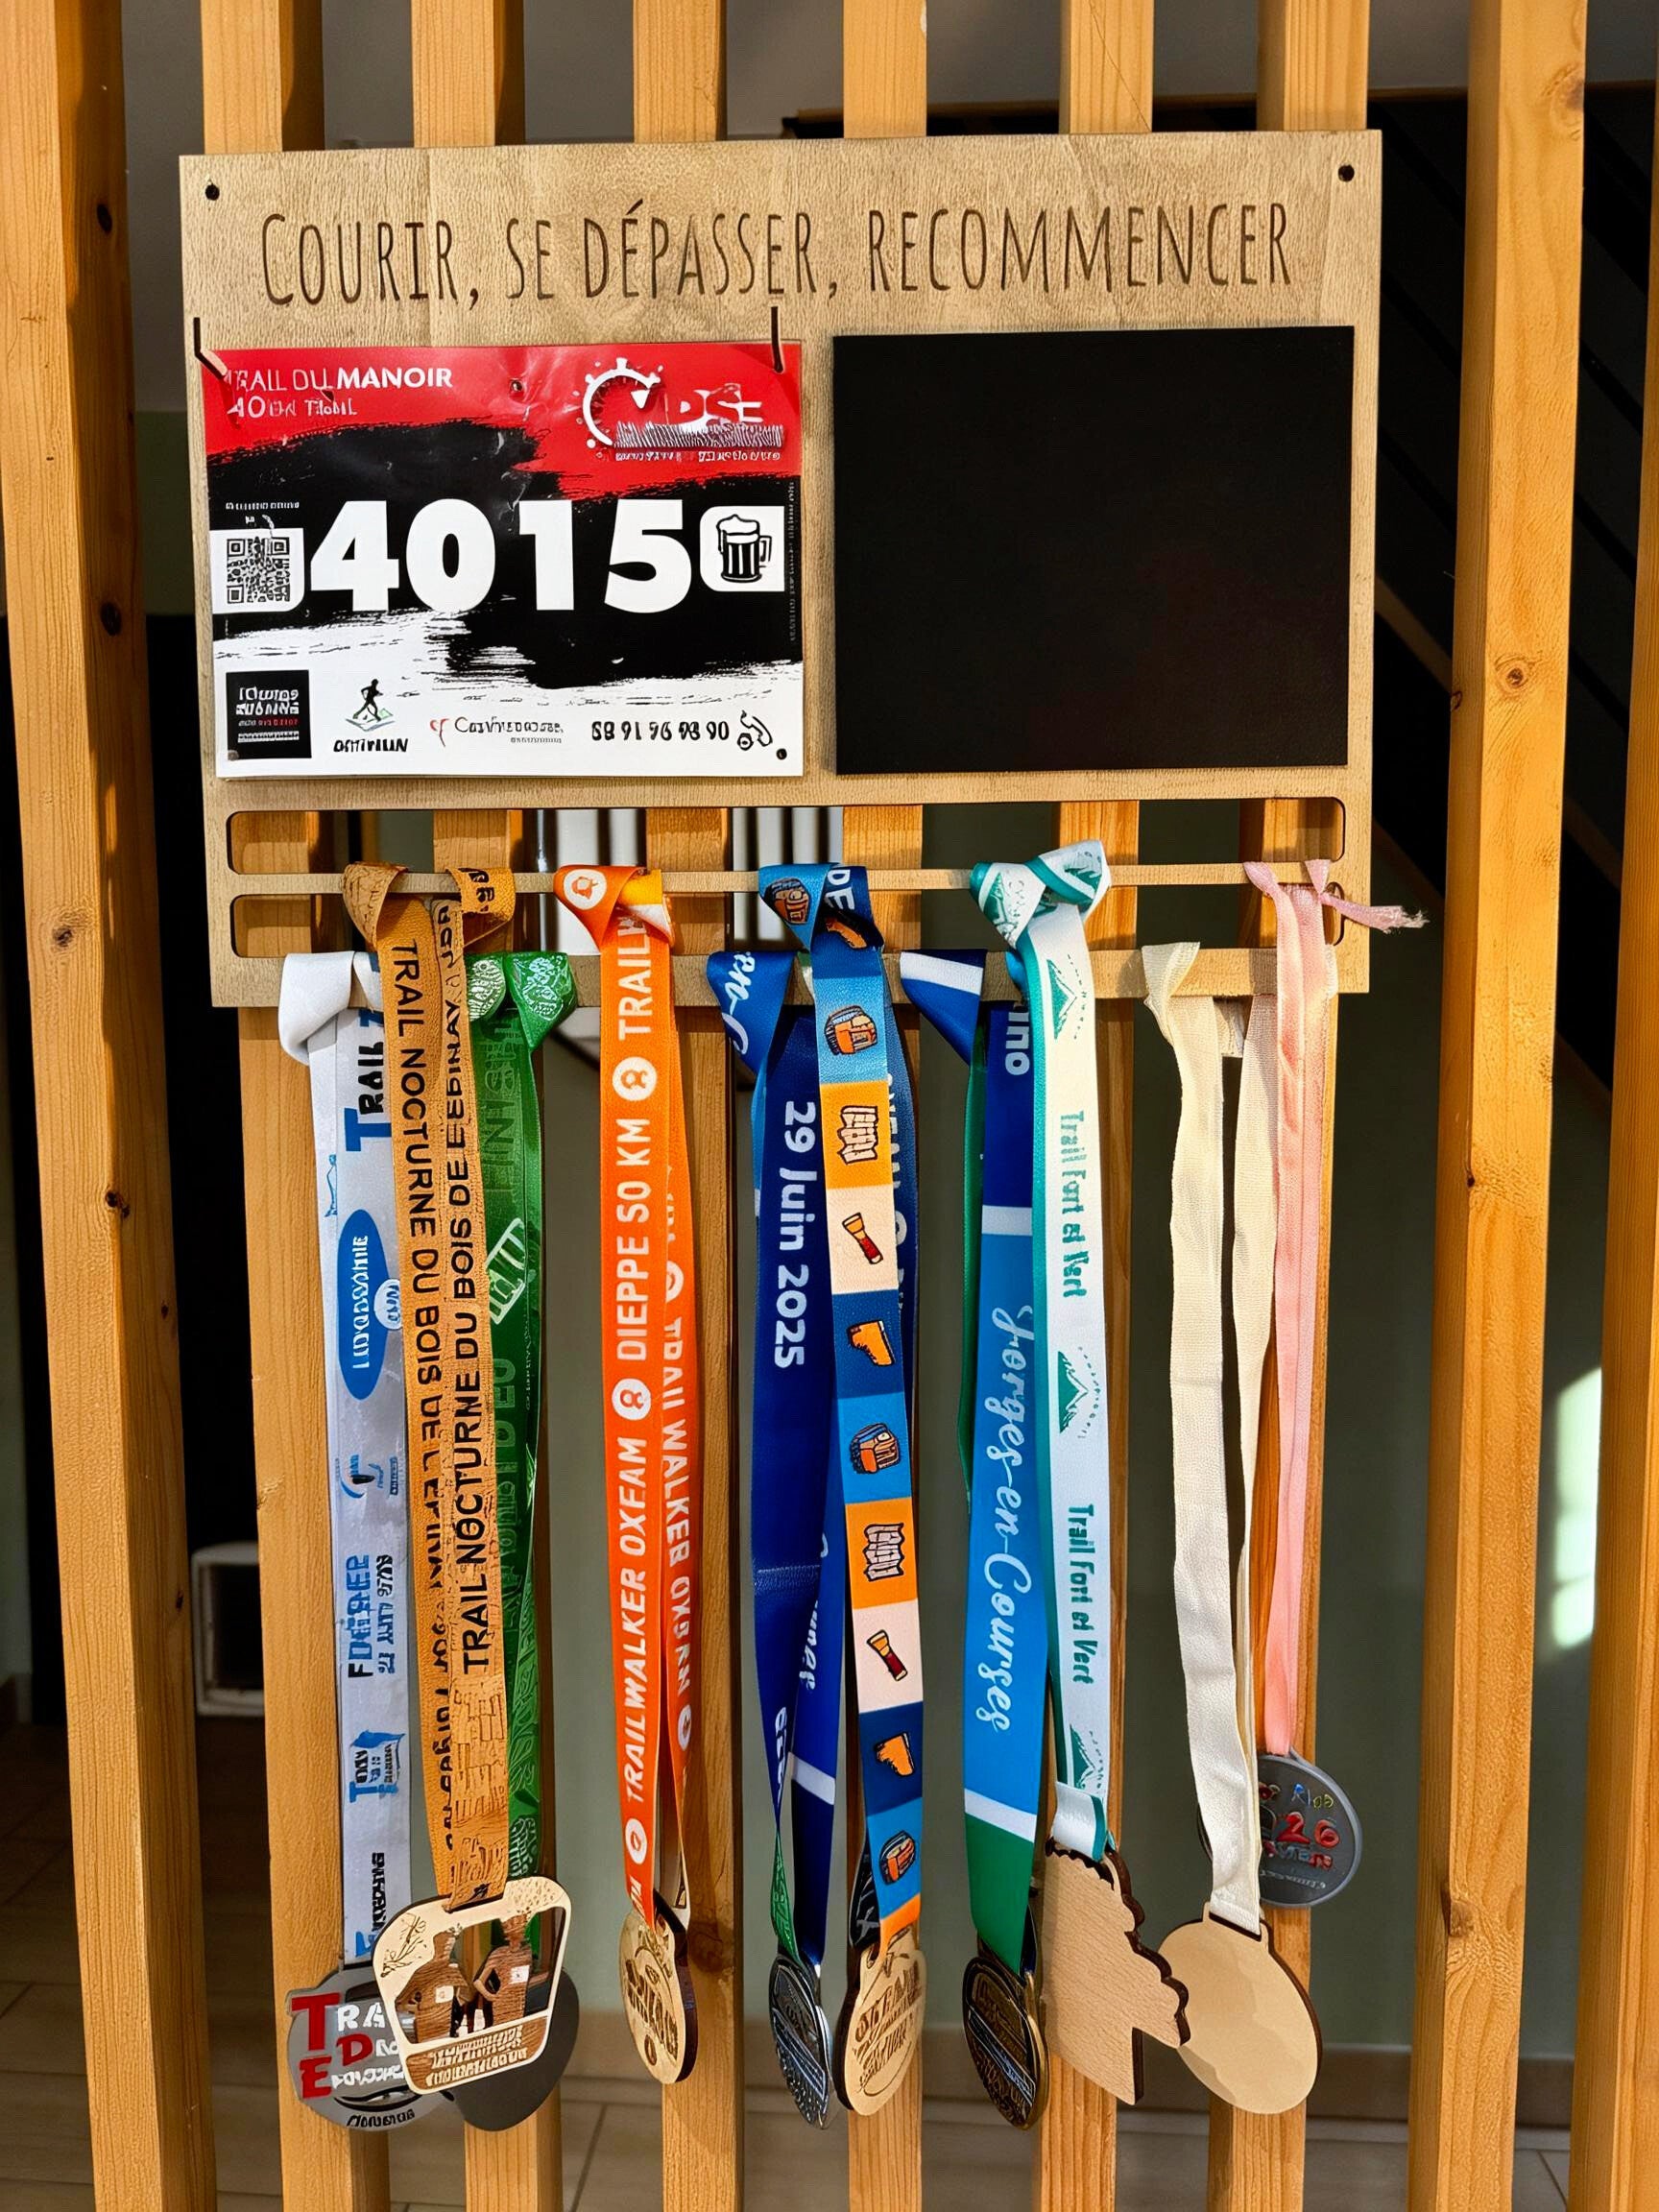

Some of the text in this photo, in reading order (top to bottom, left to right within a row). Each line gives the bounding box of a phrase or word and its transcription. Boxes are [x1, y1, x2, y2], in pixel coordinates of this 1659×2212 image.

[262, 199, 1291, 309] COURIR, SE DÉPASSER, RECOMMENCER
[336, 367, 453, 390] MANOIR
[310, 497, 692, 613] 4015
[391, 938, 425, 1037] TRAIL
[397, 1047, 436, 1238] NOCTURNE
[614, 1118, 652, 1166] KM
[1060, 1110, 1088, 1165] Trail
[446, 1160, 471, 1207] DE
[411, 1249, 442, 1295] DU
[450, 1217, 476, 1300] BOIS
[773, 1099, 819, 1370] 29 Juin 2025
[453, 1310, 479, 1359] DU
[616, 1236, 650, 1361] DIEPPE
[414, 1306, 443, 1385] BOIS
[455, 1372, 485, 1566] NOCTURNE
[1068, 1503, 1096, 1554] Trail
[617, 1437, 649, 1803] TRAILWALKER OXFAM
[1070, 1560, 1095, 1603] Fort
[463, 1575, 490, 1675] TRAIL
[1071, 1639, 1099, 1685] Vert
